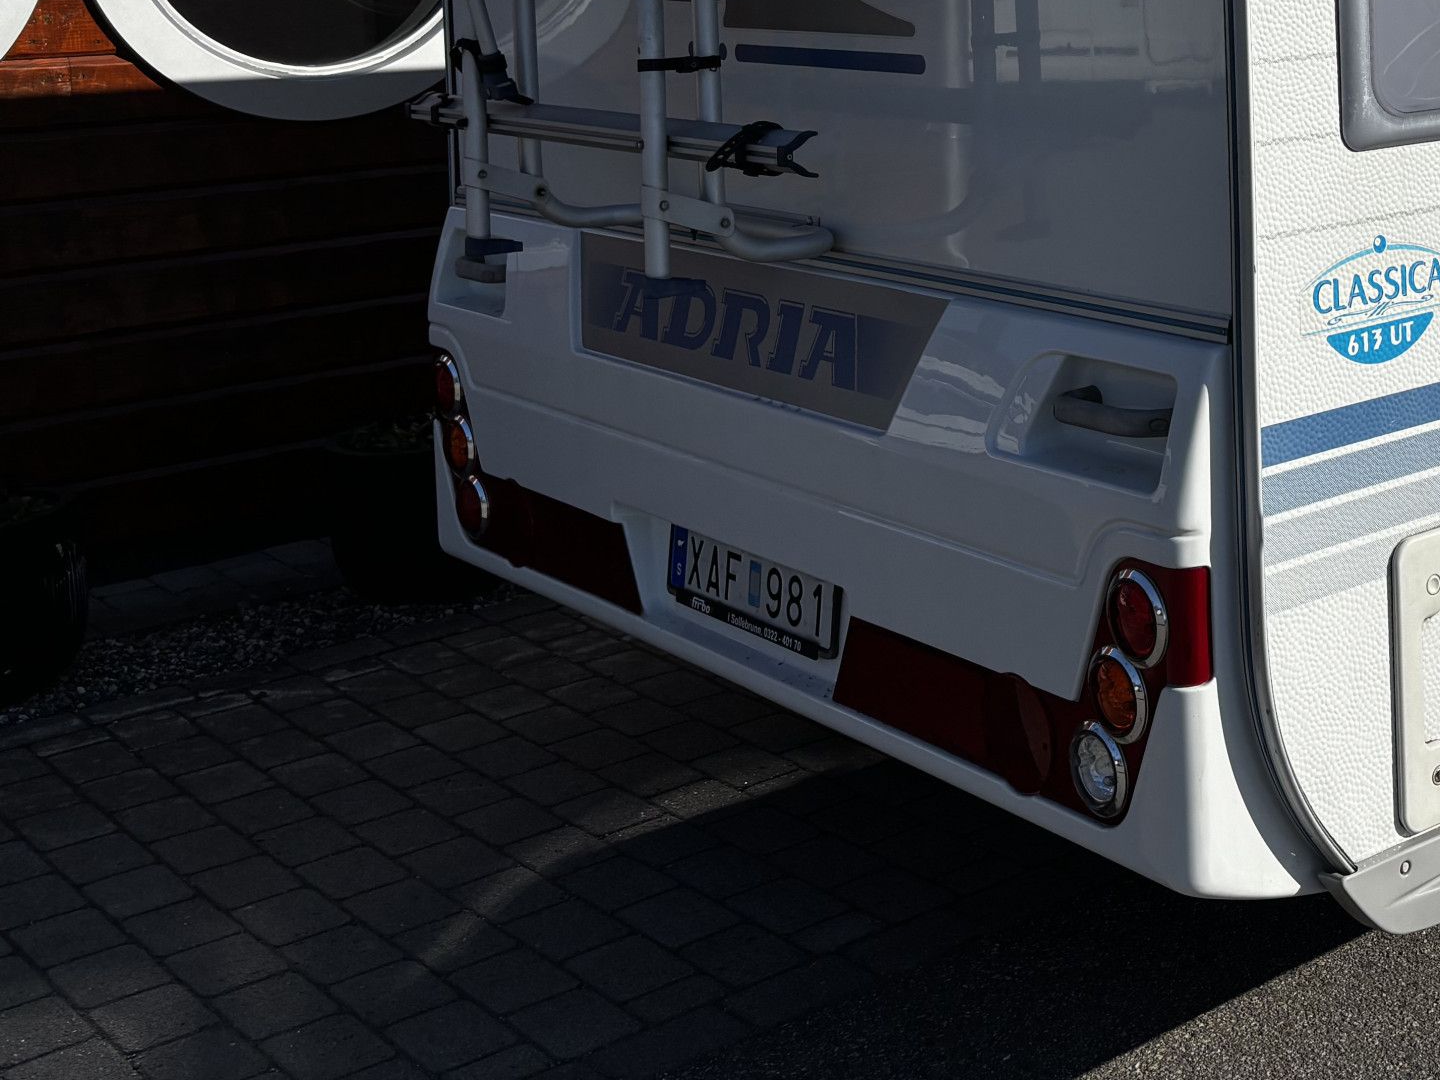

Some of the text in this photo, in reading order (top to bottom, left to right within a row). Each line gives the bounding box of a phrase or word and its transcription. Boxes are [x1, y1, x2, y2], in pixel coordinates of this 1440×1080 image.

[612, 267, 857, 391] ADRIA
[1347, 321, 1414, 356] 613 UT
[687, 536, 823, 638] XAF 981
[763, 627, 778, 642] 0322
[782, 635, 793, 649] 401
[793, 640, 802, 652] 70
